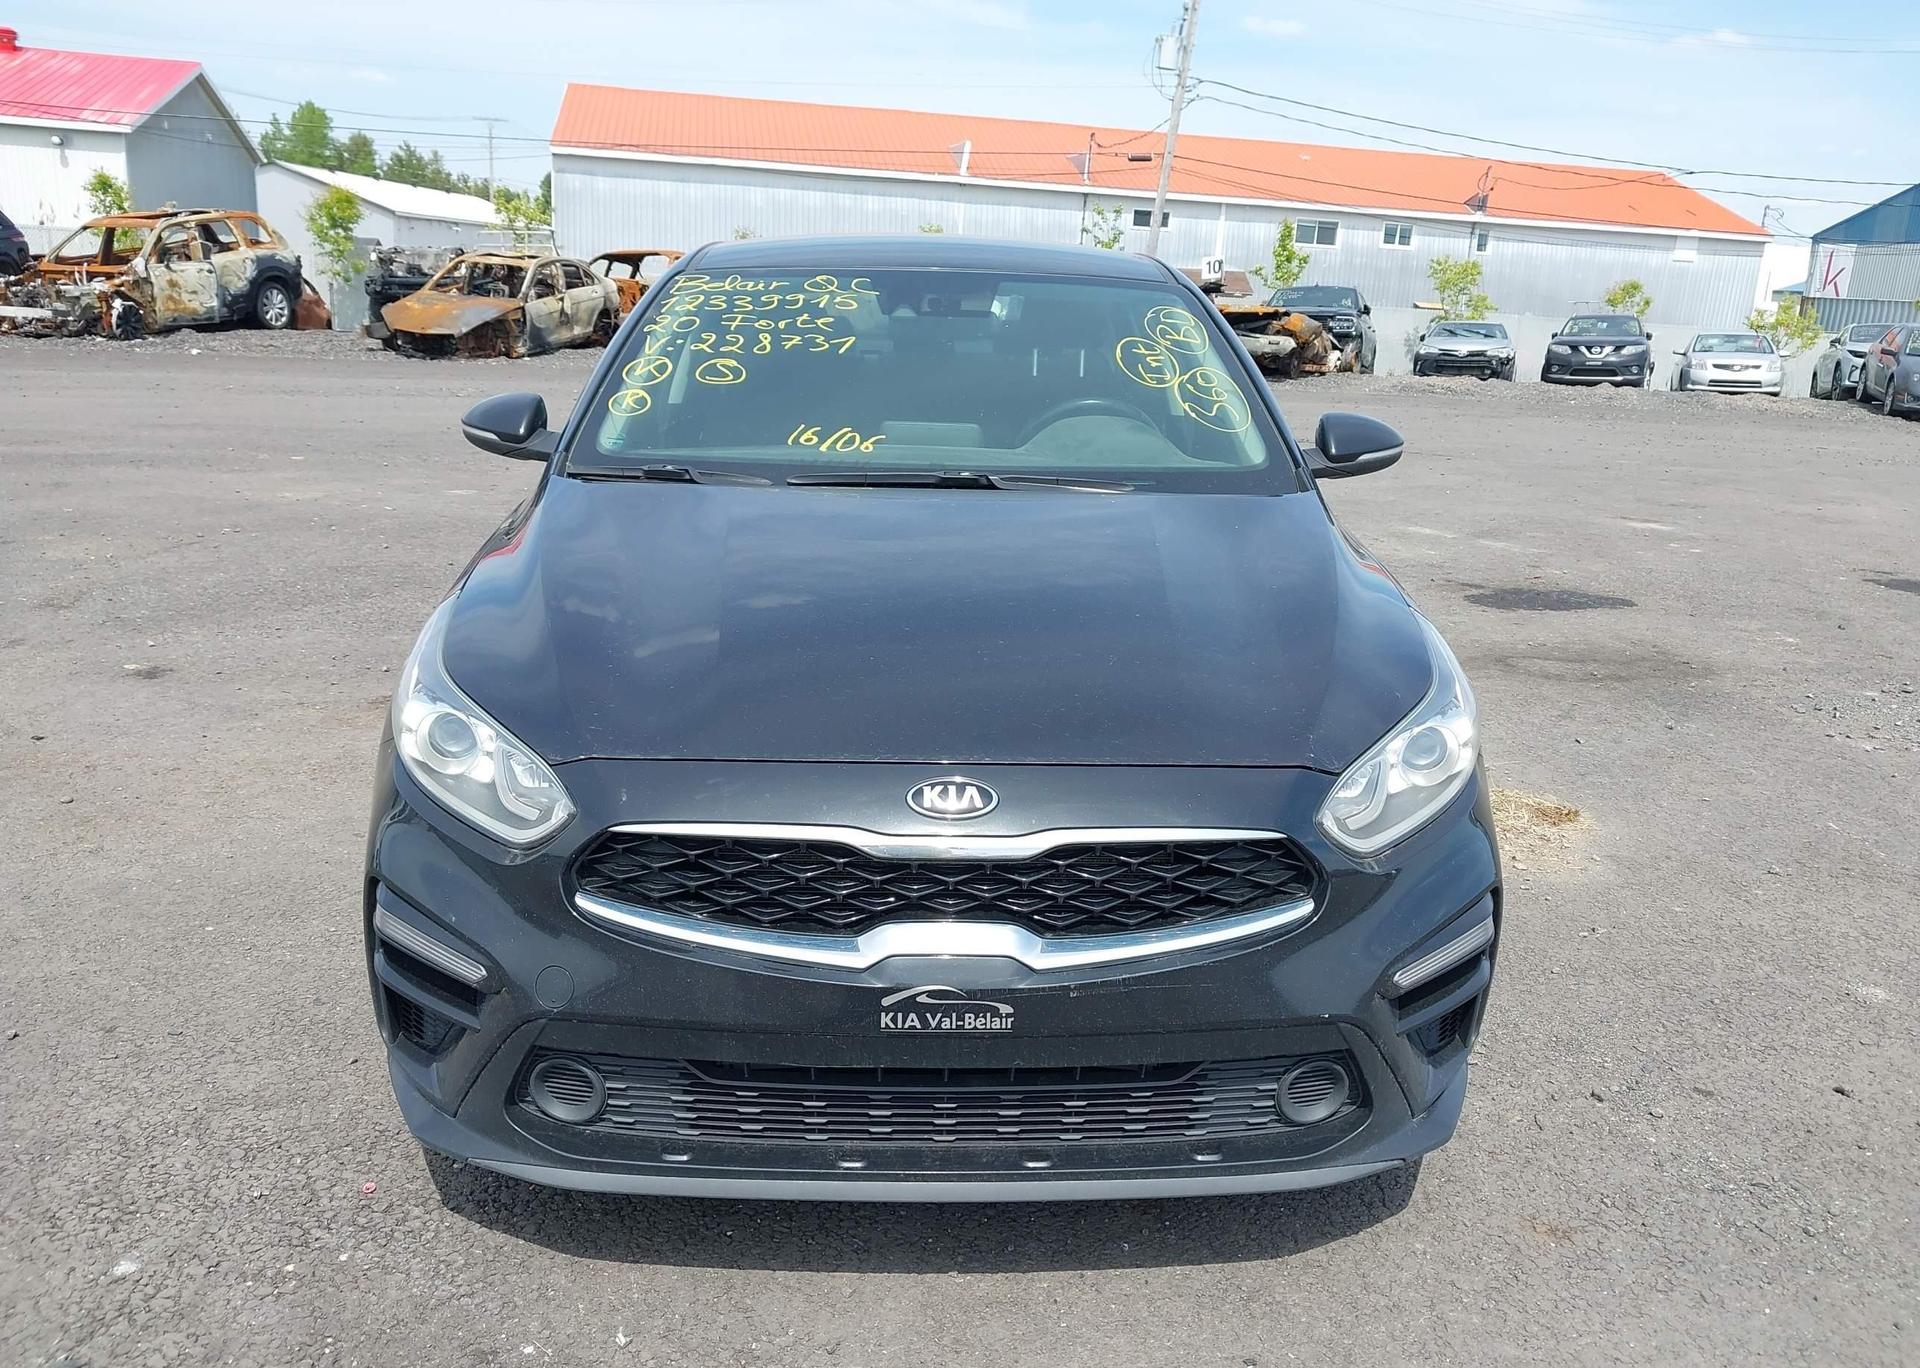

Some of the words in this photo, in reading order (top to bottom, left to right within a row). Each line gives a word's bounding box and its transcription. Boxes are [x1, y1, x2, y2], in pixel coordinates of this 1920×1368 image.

[1206, 260, 1221, 274] 10
[670, 274, 790, 295] Belair
[661, 293, 859, 313] 12339915
[643, 314, 701, 333] 20
[720, 313, 836, 332] Forte
[787, 424, 886, 452] 16/06
[921, 785, 984, 810] KIA
[880, 1012, 921, 1029] KIA
[925, 1012, 1015, 1029] Val-Bélair
